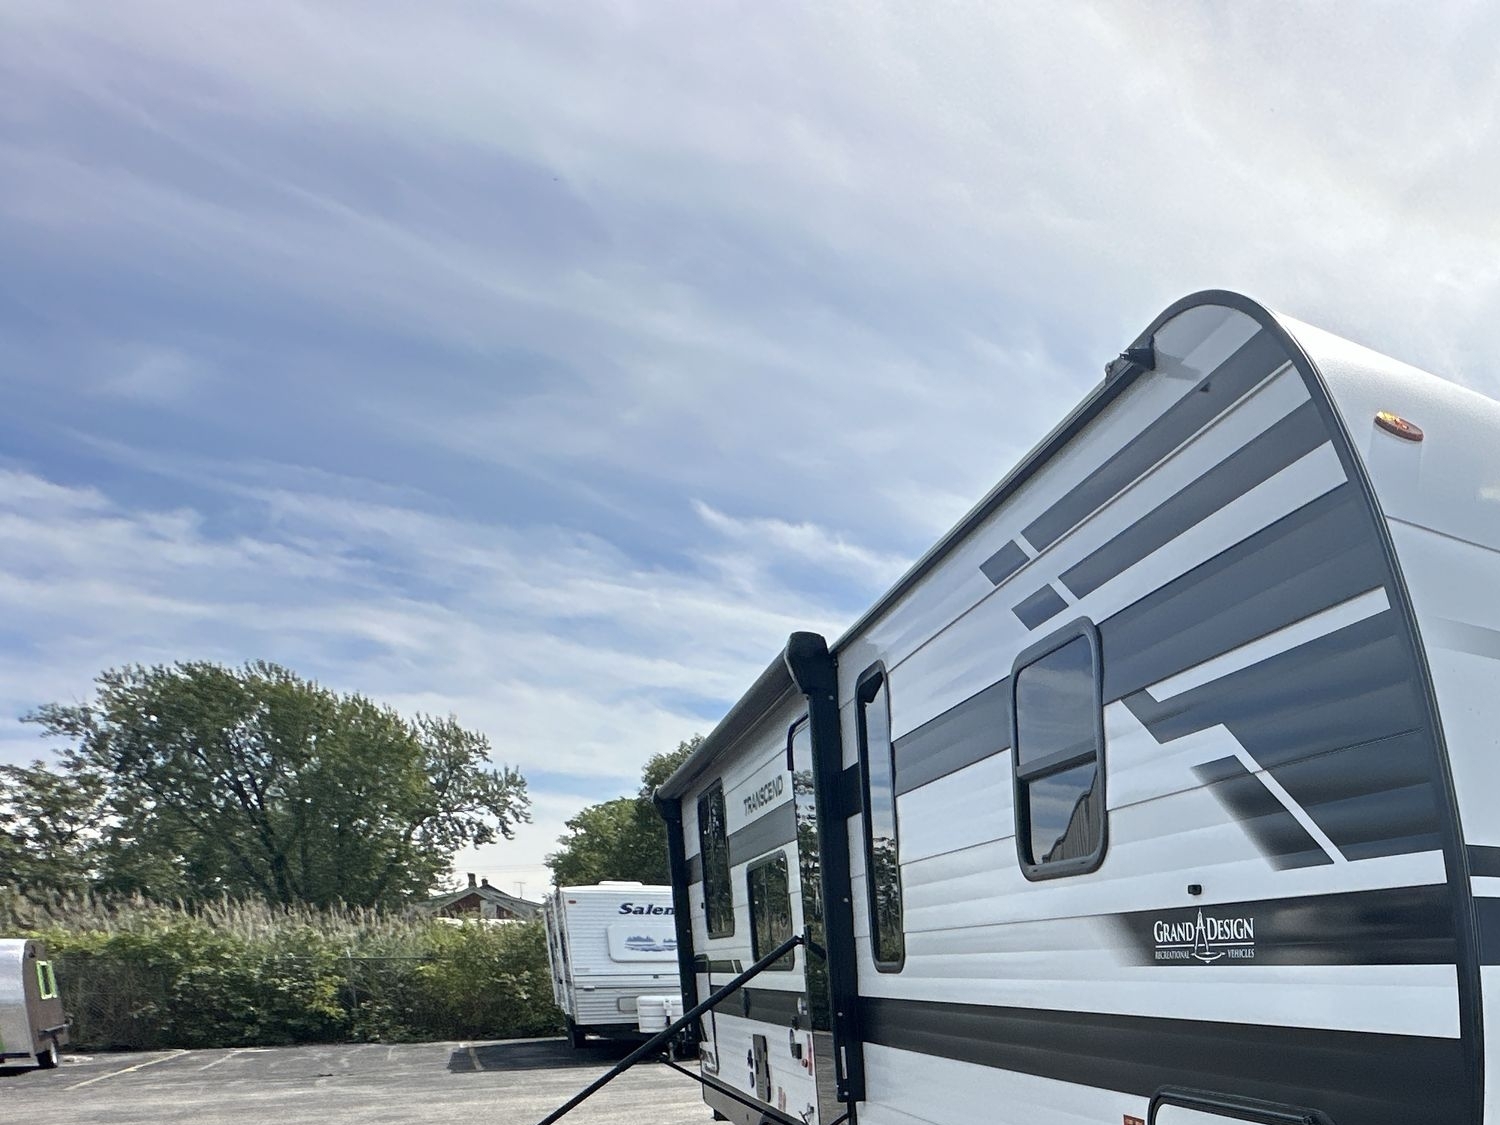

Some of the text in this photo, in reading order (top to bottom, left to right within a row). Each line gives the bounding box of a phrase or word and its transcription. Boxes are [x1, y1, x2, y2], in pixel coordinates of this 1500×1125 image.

[743, 774, 784, 817] TRANSCEND
[1153, 917, 1254, 943] GRAND DESIGN
[1227, 948, 1255, 959] VEHICLES
